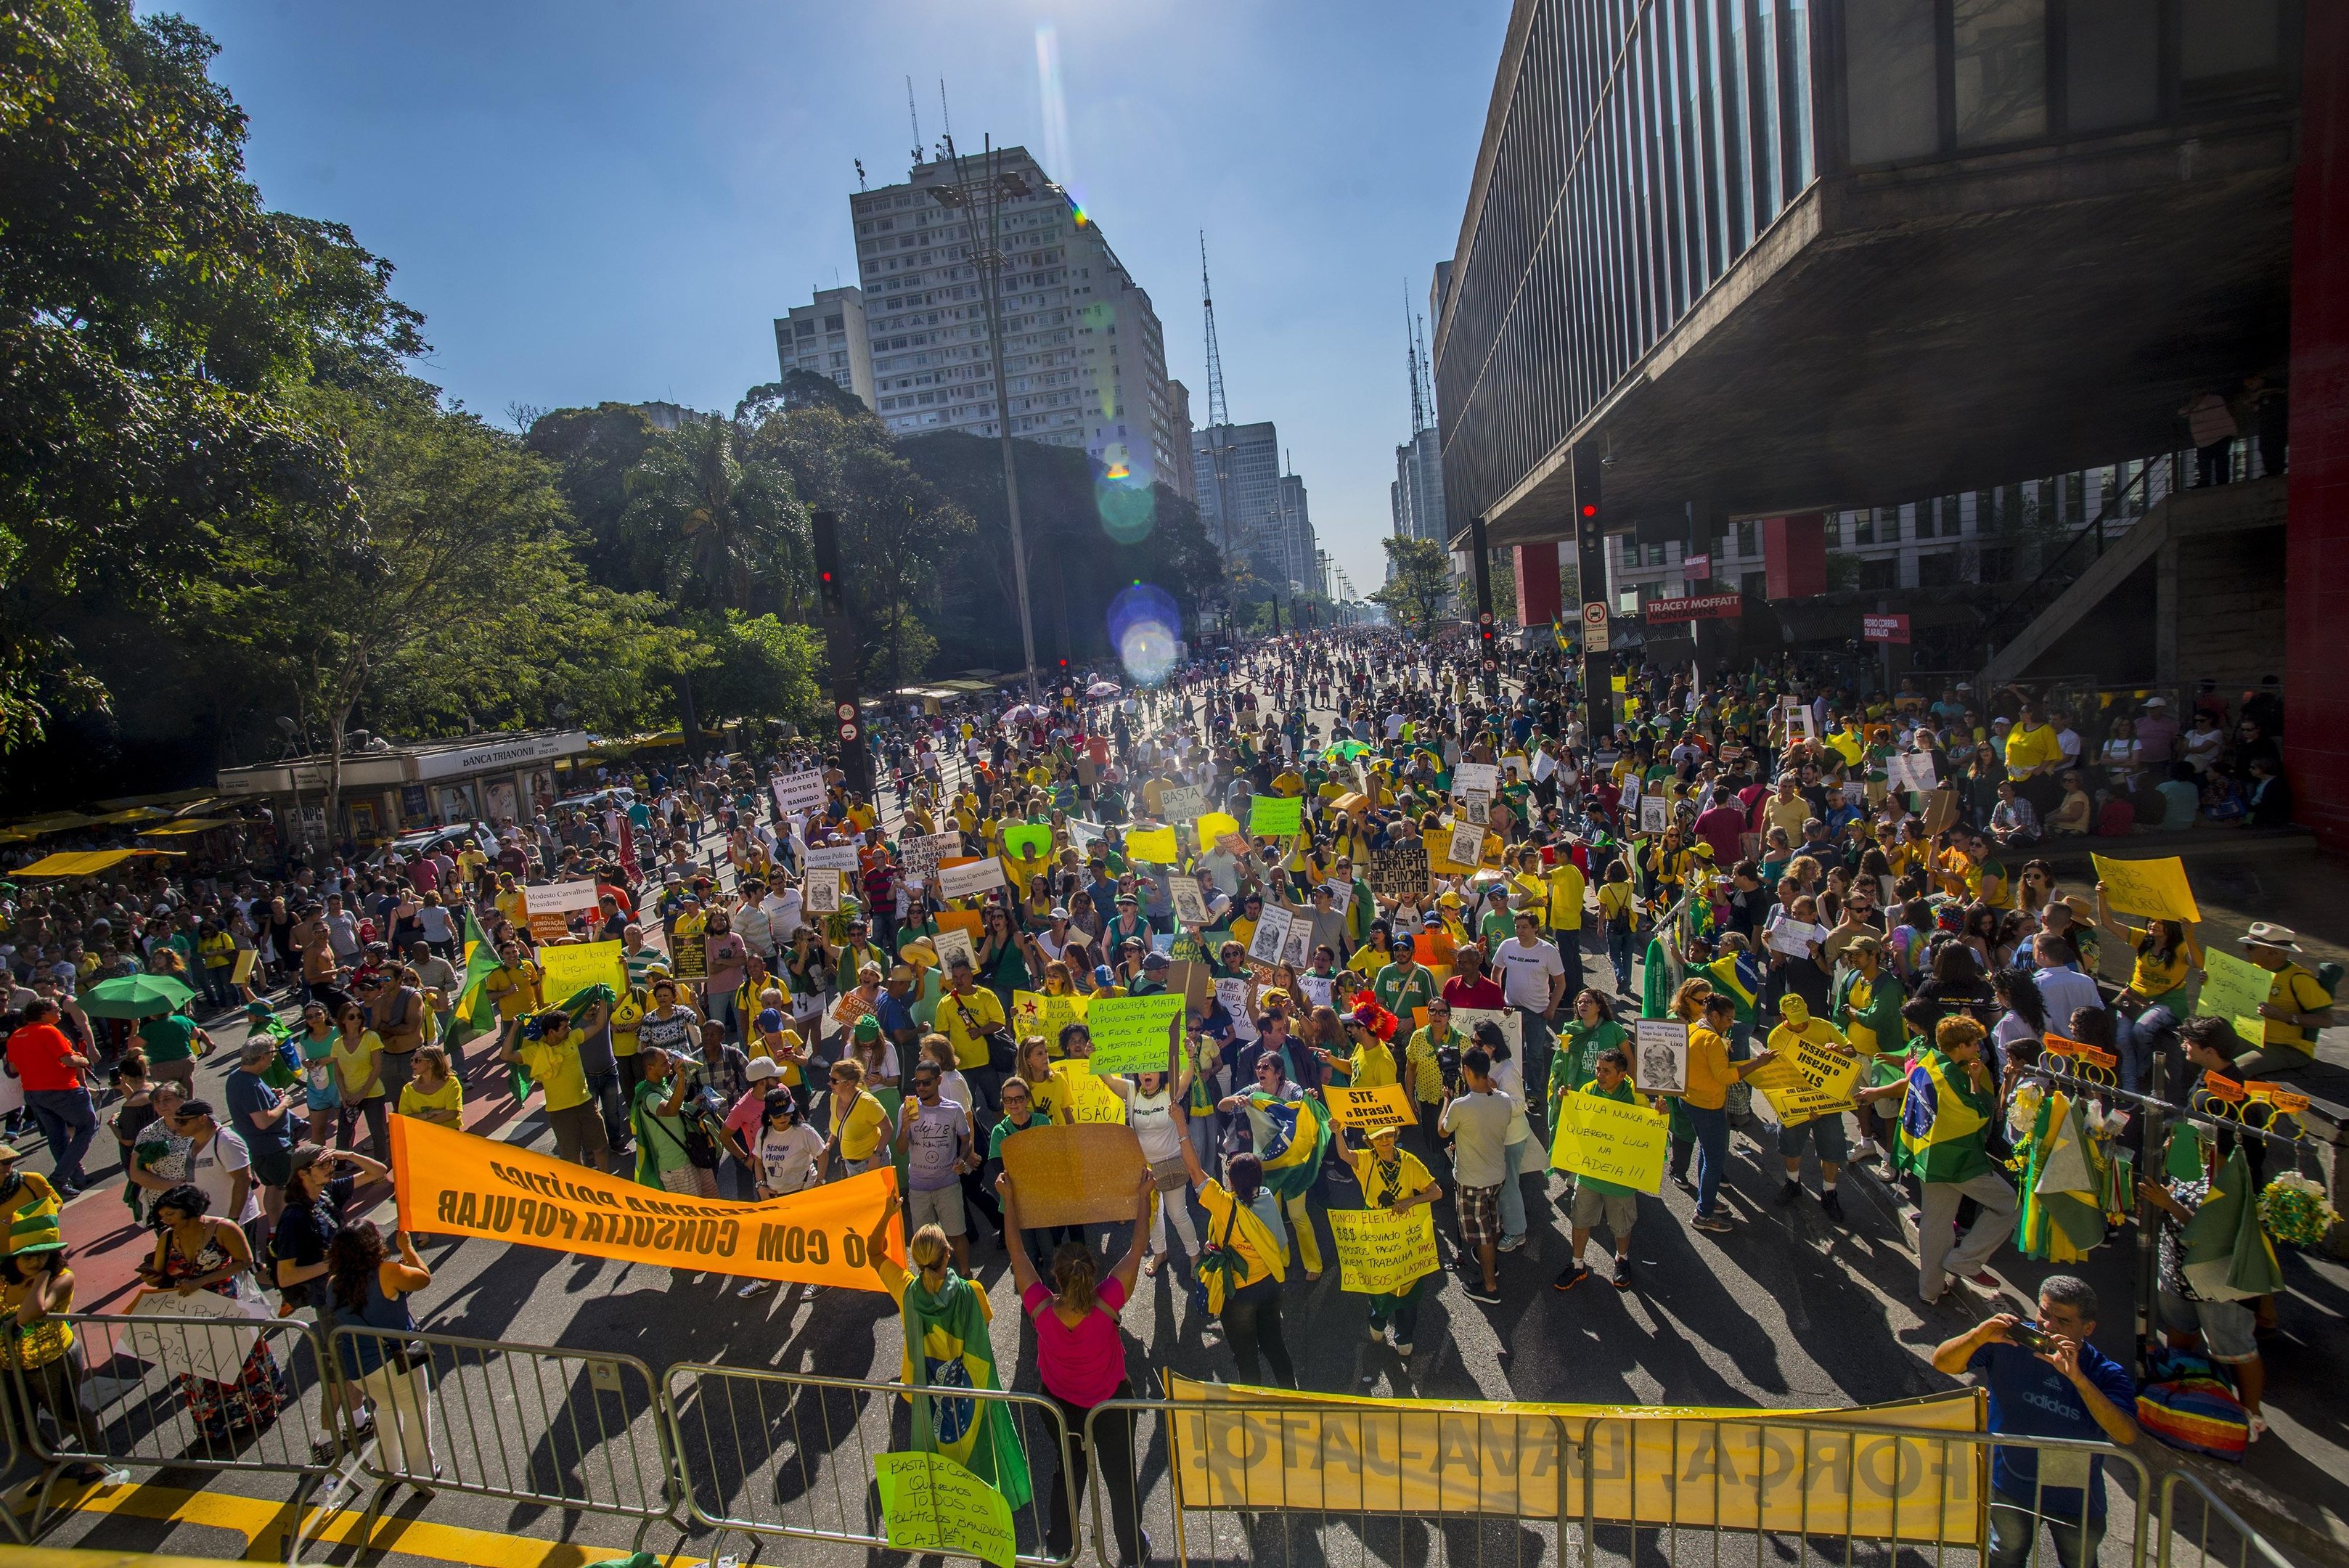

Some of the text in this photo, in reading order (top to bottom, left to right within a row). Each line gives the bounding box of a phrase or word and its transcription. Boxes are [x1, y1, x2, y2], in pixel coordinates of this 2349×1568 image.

[1649, 596, 1739, 612] TRACEY MOFFATT
[1649, 608, 1718, 621] MONTAGENS
[1864, 618, 1898, 628] PEDRO CORREIA
[463, 754, 492, 767] BANCA
[783, 783, 818, 794] PROTEGE
[788, 794, 820, 806] BANDIDO
[1163, 787, 1201, 805] BASTA
[911, 840, 939, 849] MENDES
[922, 842, 960, 854] ALEXANDRE
[832, 852, 853, 860] Política
[1370, 848, 1427, 861] CONGRESSO
[1370, 859, 1428, 872] CORRUPTO
[943, 867, 1000, 884] Modesto Carvalhosa
[944, 883, 973, 891] Presidente
[528, 887, 594, 901] Modesto Carvalhosa
[529, 900, 563, 909] Presidente
[544, 950, 579, 963] Gilmar
[2209, 953, 2216, 965] O
[2219, 958, 2244, 979] BRASIL
[1221, 993, 1241, 1003] MARIA
[1043, 1000, 1071, 1010] ONDE
[1098, 997, 1180, 1013] A CORRUPÇÃO MATA!
[1124, 1011, 1145, 1021] ESTÁ
[1096, 1055, 1122, 1066] BASTA
[1798, 1039, 1851, 1069] tem PRESSA
[1108, 1060, 1168, 1073] CORRUPTOS
[1797, 1052, 1832, 1077] Brasil
[1098, 1095, 1111, 1105] NA
[1349, 1090, 1378, 1104] STF,
[1799, 1095, 1810, 1103] Não
[1353, 1104, 1394, 1117] Brasil
[1574, 1099, 1607, 1114] LULA
[1612, 1109, 1643, 1123] NUNCA
[1790, 1100, 1852, 1114] Abuso de Autoridade
[1365, 1115, 1405, 1126] PRESSA
[1566, 1122, 1649, 1149] QUEREMOS LULA
[1598, 1146, 1611, 1156] NA
[1405, 1224, 1421, 1236] dos
[1376, 1234, 1423, 1254] PAGOS POR
[1341, 1257, 1363, 1267] QUEM
[1367, 1249, 1413, 1268] TRABALHA
[1344, 1273, 1355, 1285] OS
[1357, 1272, 1392, 1286] BOLSOS
[1404, 1255, 1439, 1277] LADRÕES
[2022, 1391, 2080, 1420] adidas
[889, 1458, 945, 1476] BASTA DE
[902, 1491, 989, 1516] TODOS OS
[943, 1527, 961, 1535] NA
[955, 1515, 1014, 1541] BANDIDOS
